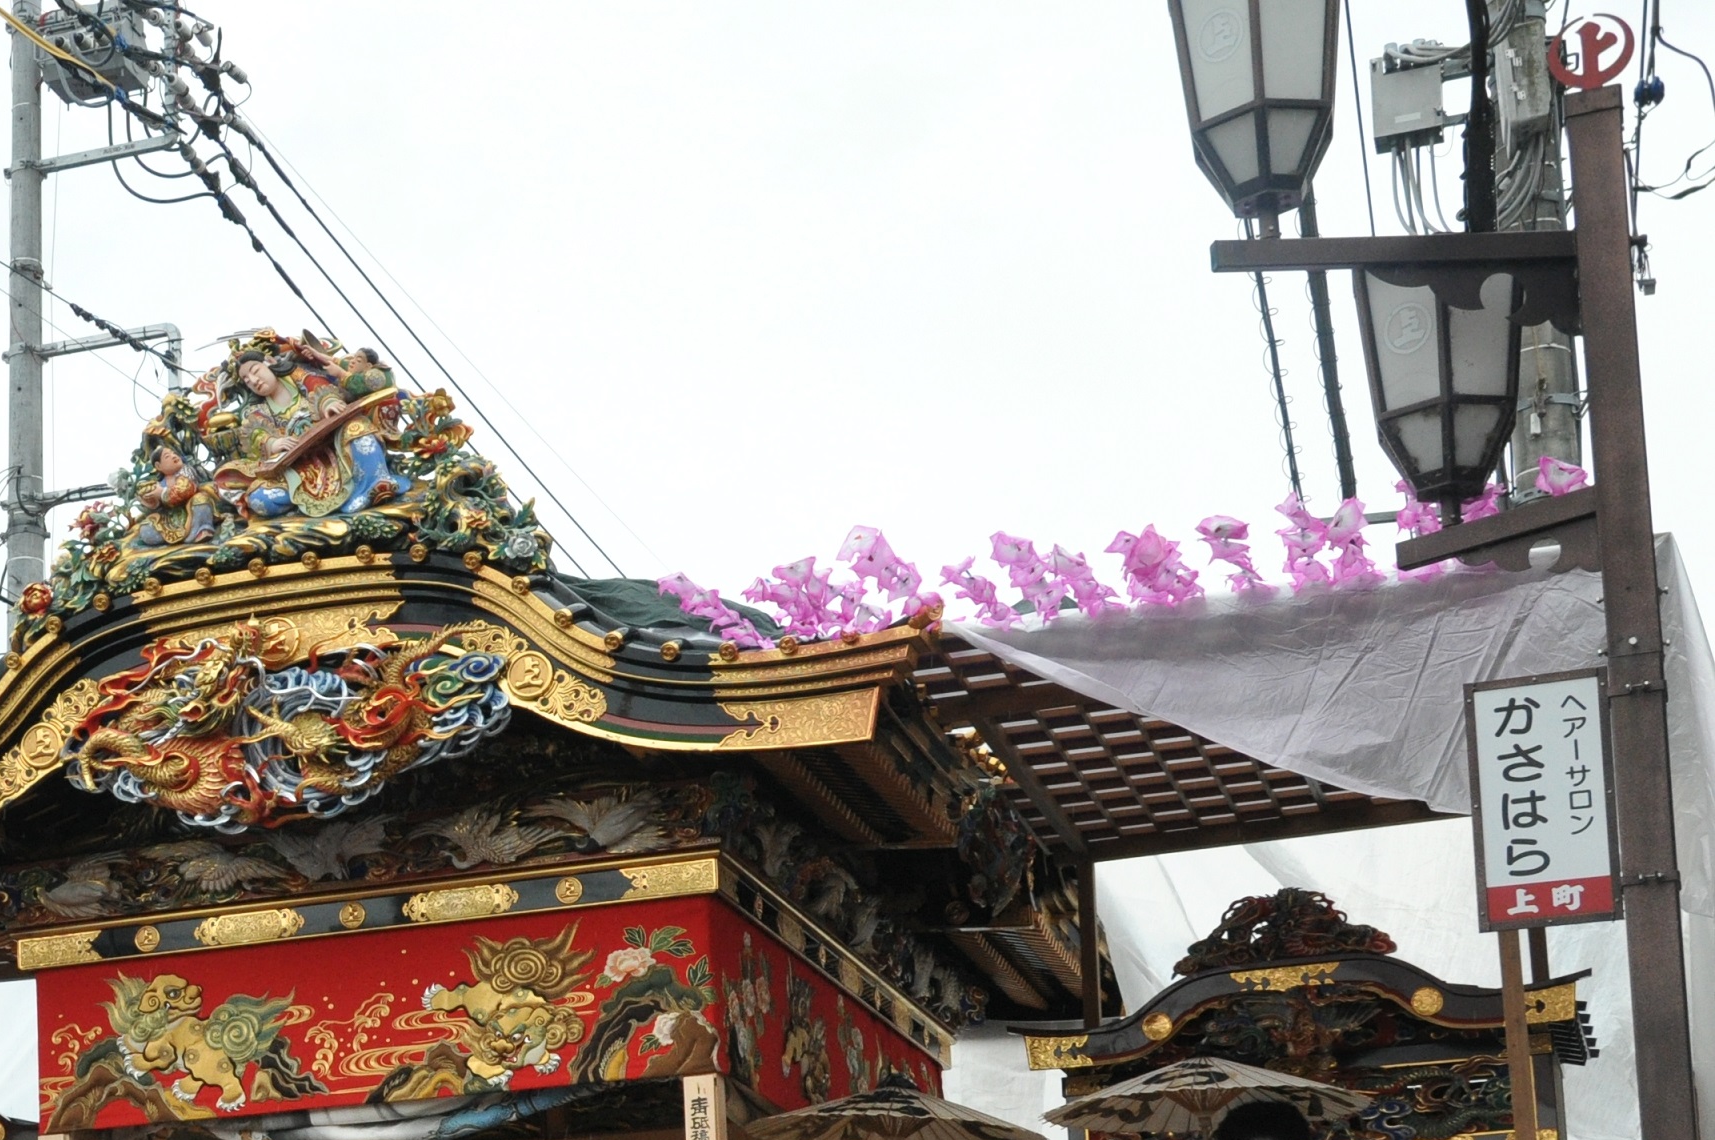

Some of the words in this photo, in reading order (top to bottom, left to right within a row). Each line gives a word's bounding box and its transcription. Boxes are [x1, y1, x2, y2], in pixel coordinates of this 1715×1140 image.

[1493, 697, 1551, 876] かさはら
[1561, 694, 1594, 835] ヘアーサロン
[1507, 884, 1585, 916] 上町
